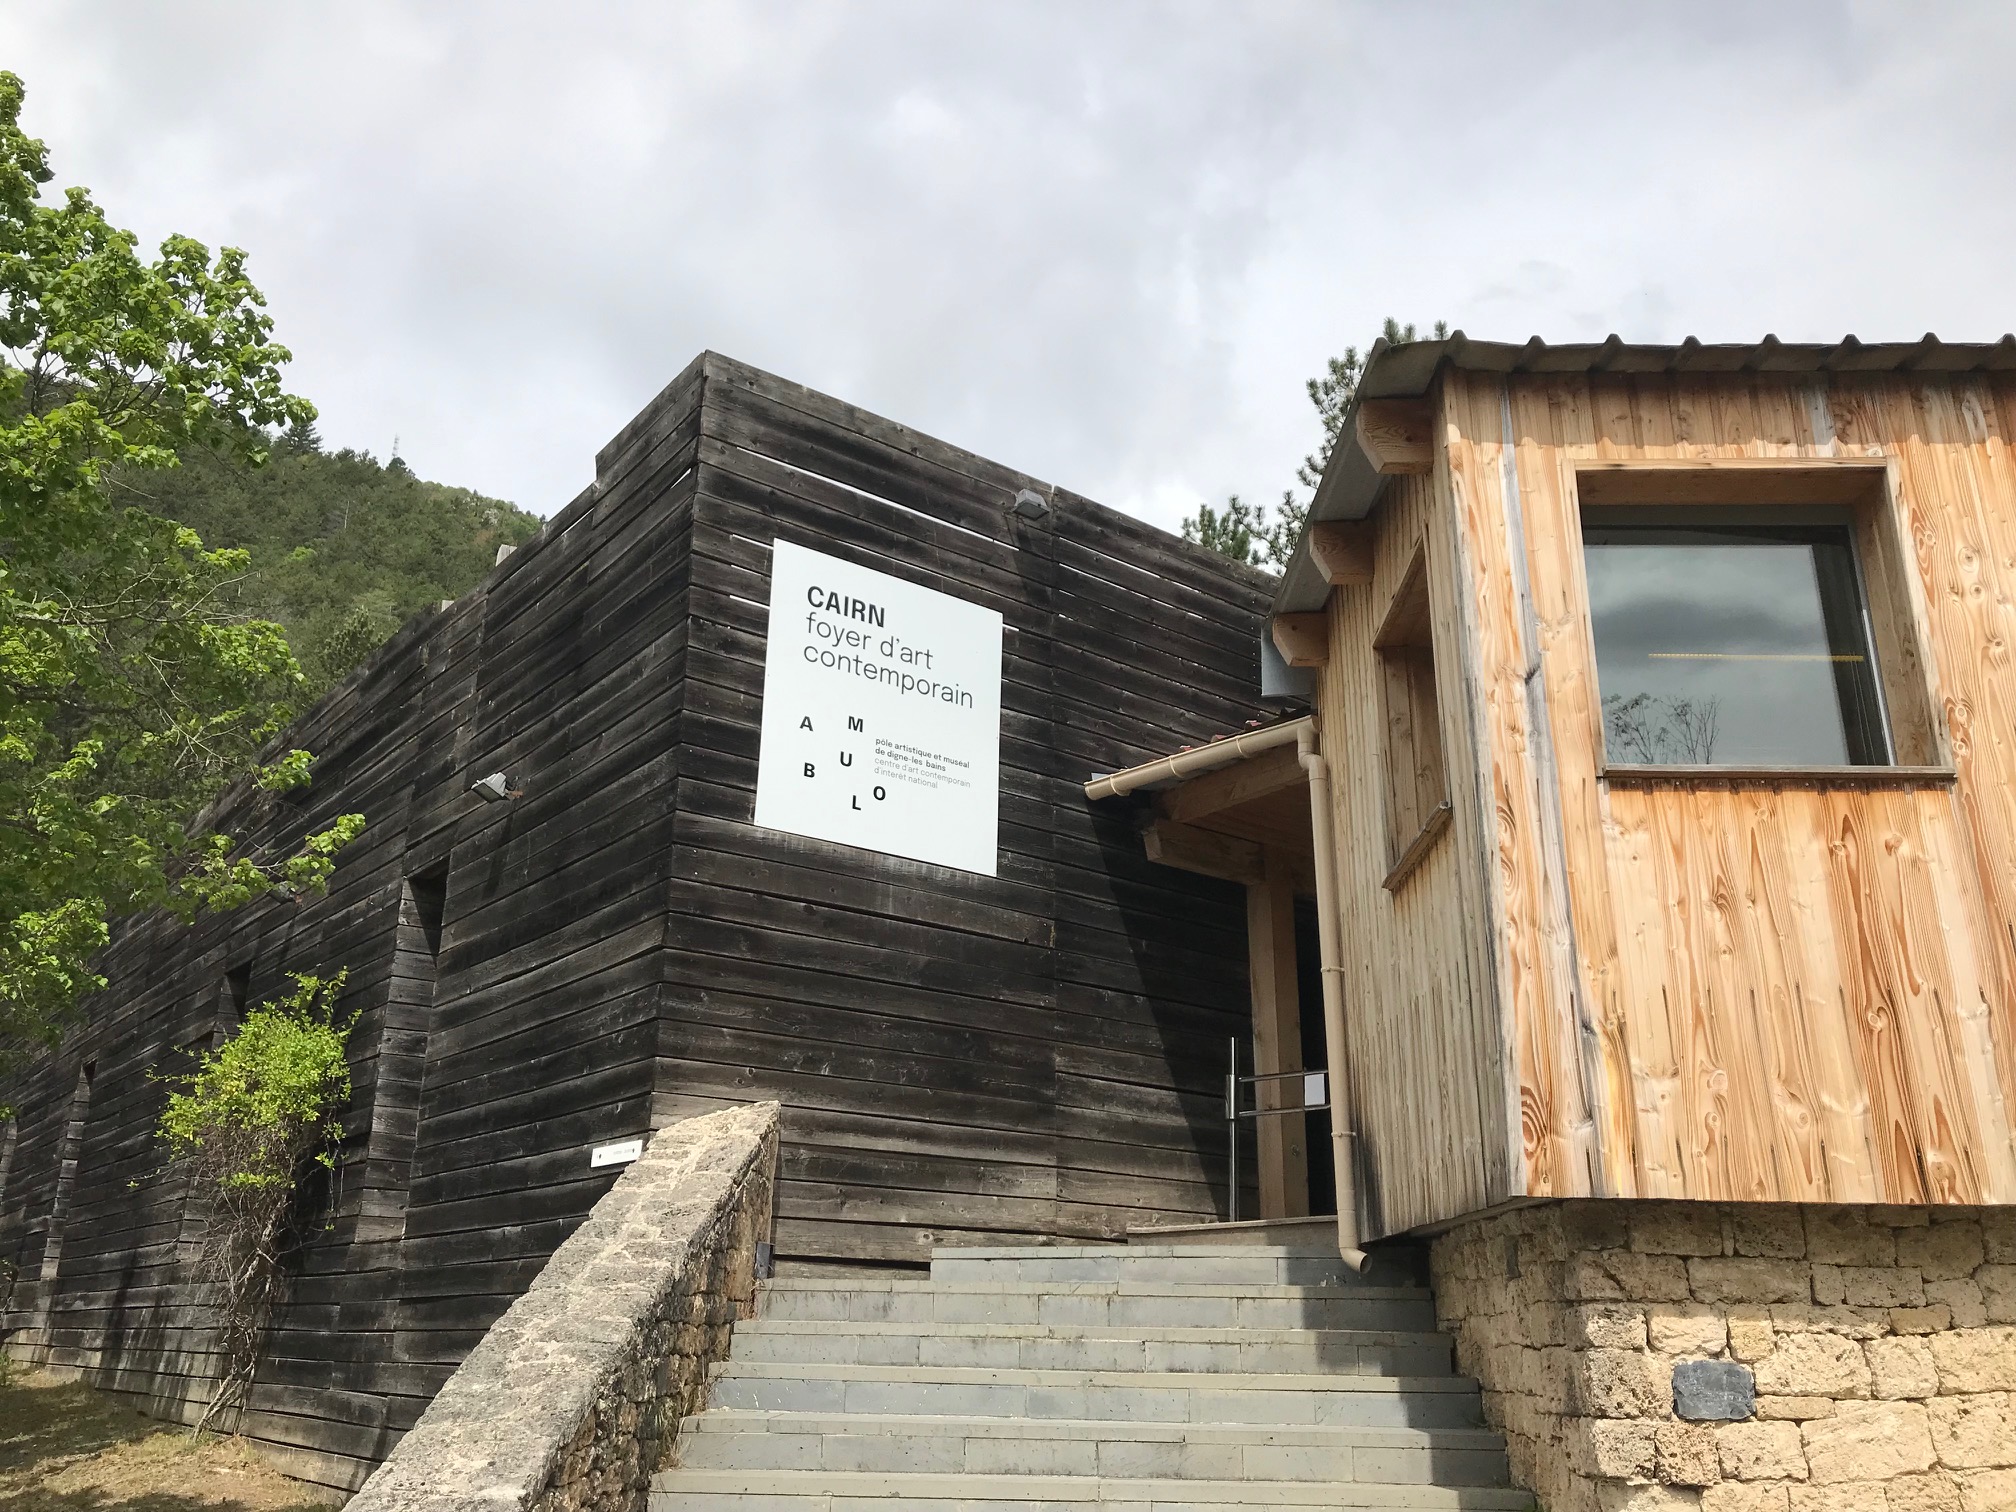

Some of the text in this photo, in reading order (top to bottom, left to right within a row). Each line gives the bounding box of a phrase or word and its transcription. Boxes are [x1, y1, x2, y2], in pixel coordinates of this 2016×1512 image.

[807, 585, 885, 628] CAIRN
[806, 612, 872, 649] foyer
[803, 646, 973, 709] contemporain
[799, 716, 814, 731] A
[848, 716, 864, 733] M
[840, 751, 853, 767] U
[875, 738, 970, 769] pôle artistique et muséal
[875, 747, 886, 755] de
[925, 760, 947, 772] bains
[803, 762, 816, 778] B
[874, 757, 901, 770] centre
[920, 769, 971, 788] contemporain
[908, 776, 938, 789] national
[873, 786, 887, 802] O
[852, 795, 862, 811] L
